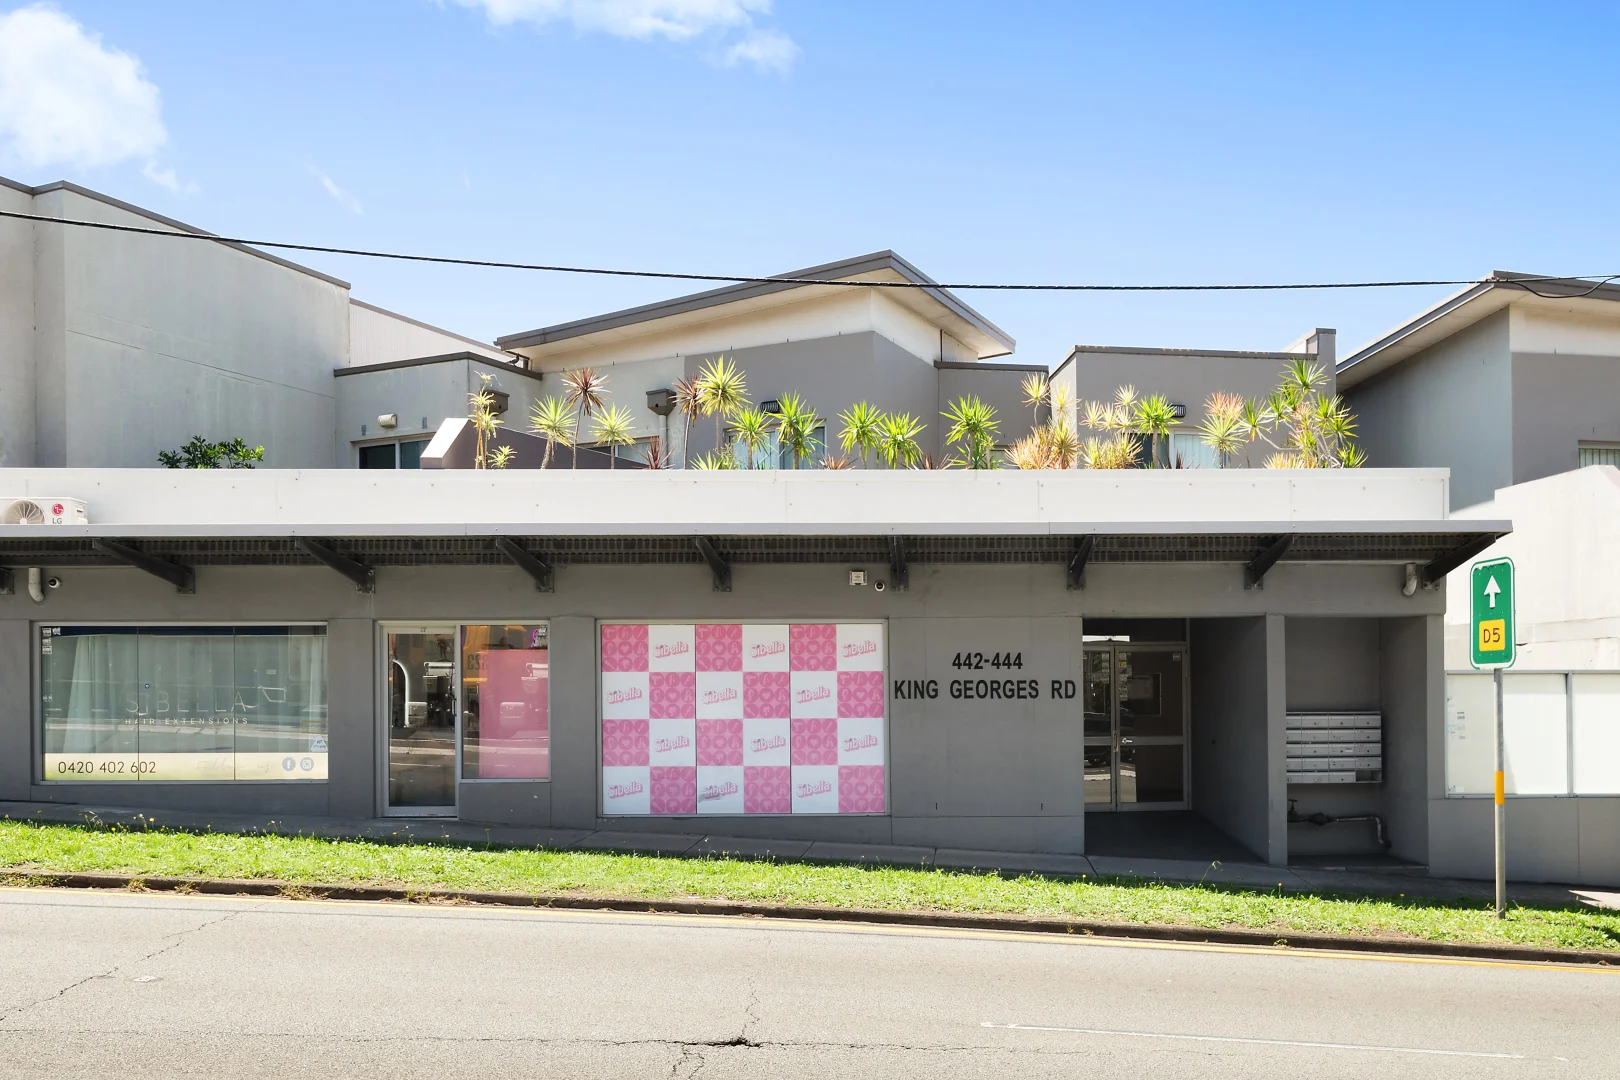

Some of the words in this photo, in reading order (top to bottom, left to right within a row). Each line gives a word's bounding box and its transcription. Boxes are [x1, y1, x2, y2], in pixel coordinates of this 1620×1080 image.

[1483, 628, 1501, 644] D5
[652, 640, 689, 659] Sibella
[750, 640, 786, 659] Sibella
[840, 640, 877, 659] Sibella
[952, 652, 1023, 670] 442-444
[606, 687, 643, 706] Sibella
[702, 687, 738, 706] Sibella
[795, 687, 831, 705] Sibella
[894, 680, 939, 699] KING
[949, 680, 1039, 699] GEORGES
[1051, 680, 1076, 699] RD
[125, 717, 156, 725] HAIR
[165, 717, 248, 725] EXTENSIONS
[654, 735, 690, 754] Sibella
[750, 735, 787, 753] Sibella
[841, 735, 878, 753] Sibella
[58, 761, 94, 774] 0420
[99, 761, 125, 774] 402
[130, 761, 156, 774] 602
[606, 780, 643, 800] Sibella
[703, 781, 739, 800] Sibella
[796, 780, 832, 799] Sibella
